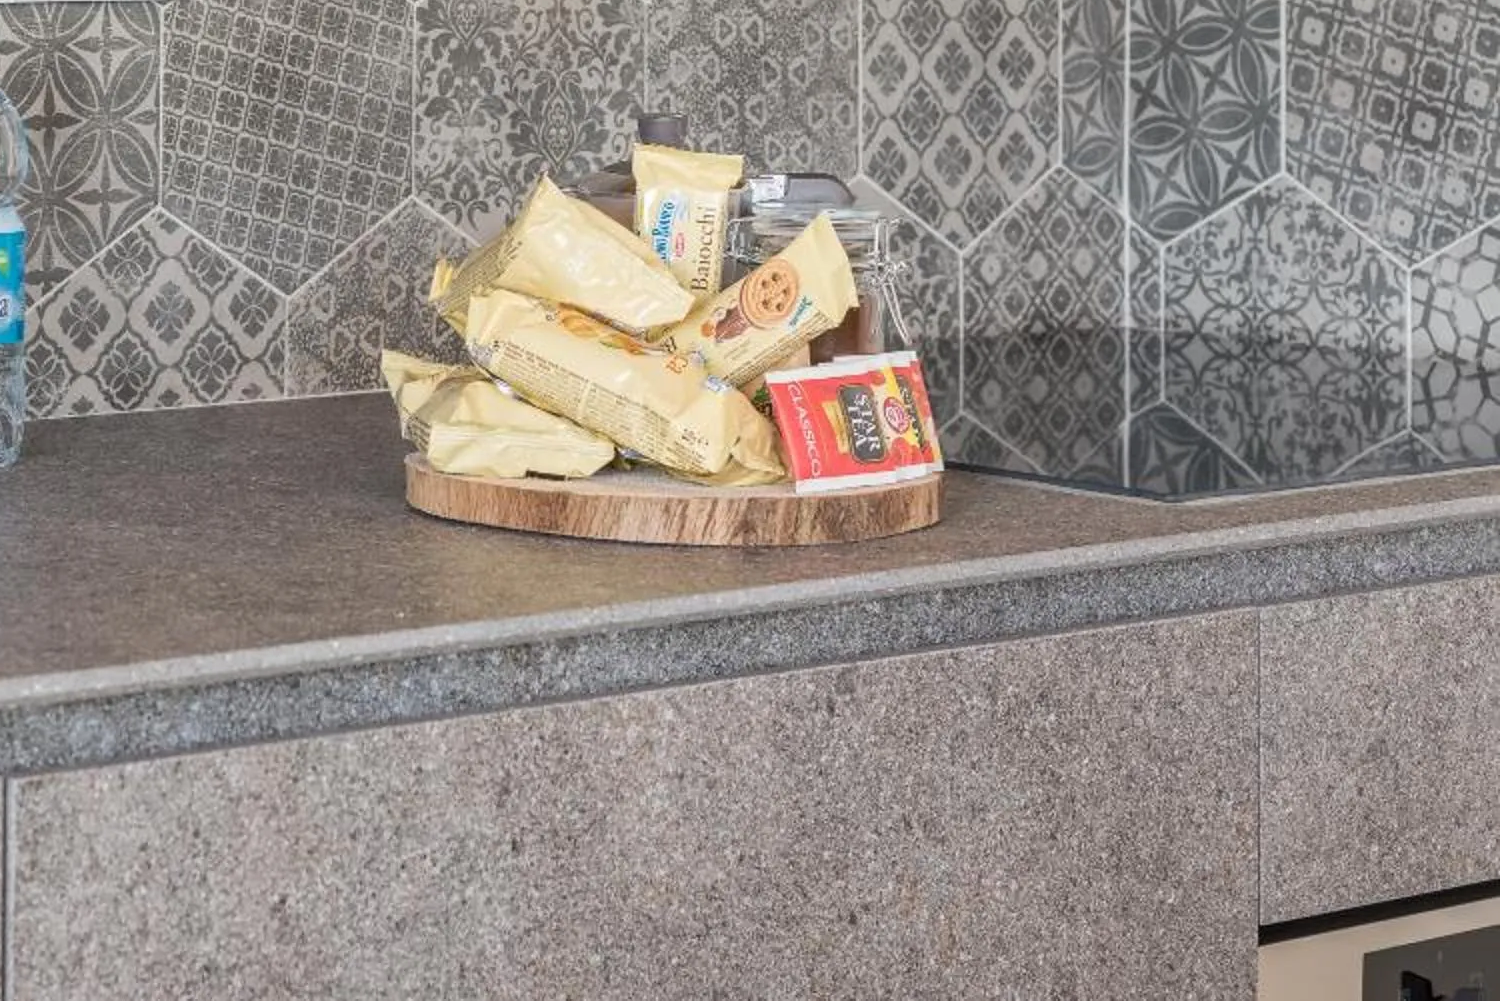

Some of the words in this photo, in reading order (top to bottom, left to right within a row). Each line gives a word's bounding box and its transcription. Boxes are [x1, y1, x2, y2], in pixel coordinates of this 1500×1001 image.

[691, 206, 716, 290] Baiocchi
[788, 383, 821, 477] CLASSICO
[848, 406, 867, 449] TEA
[854, 394, 881, 452] STAR
